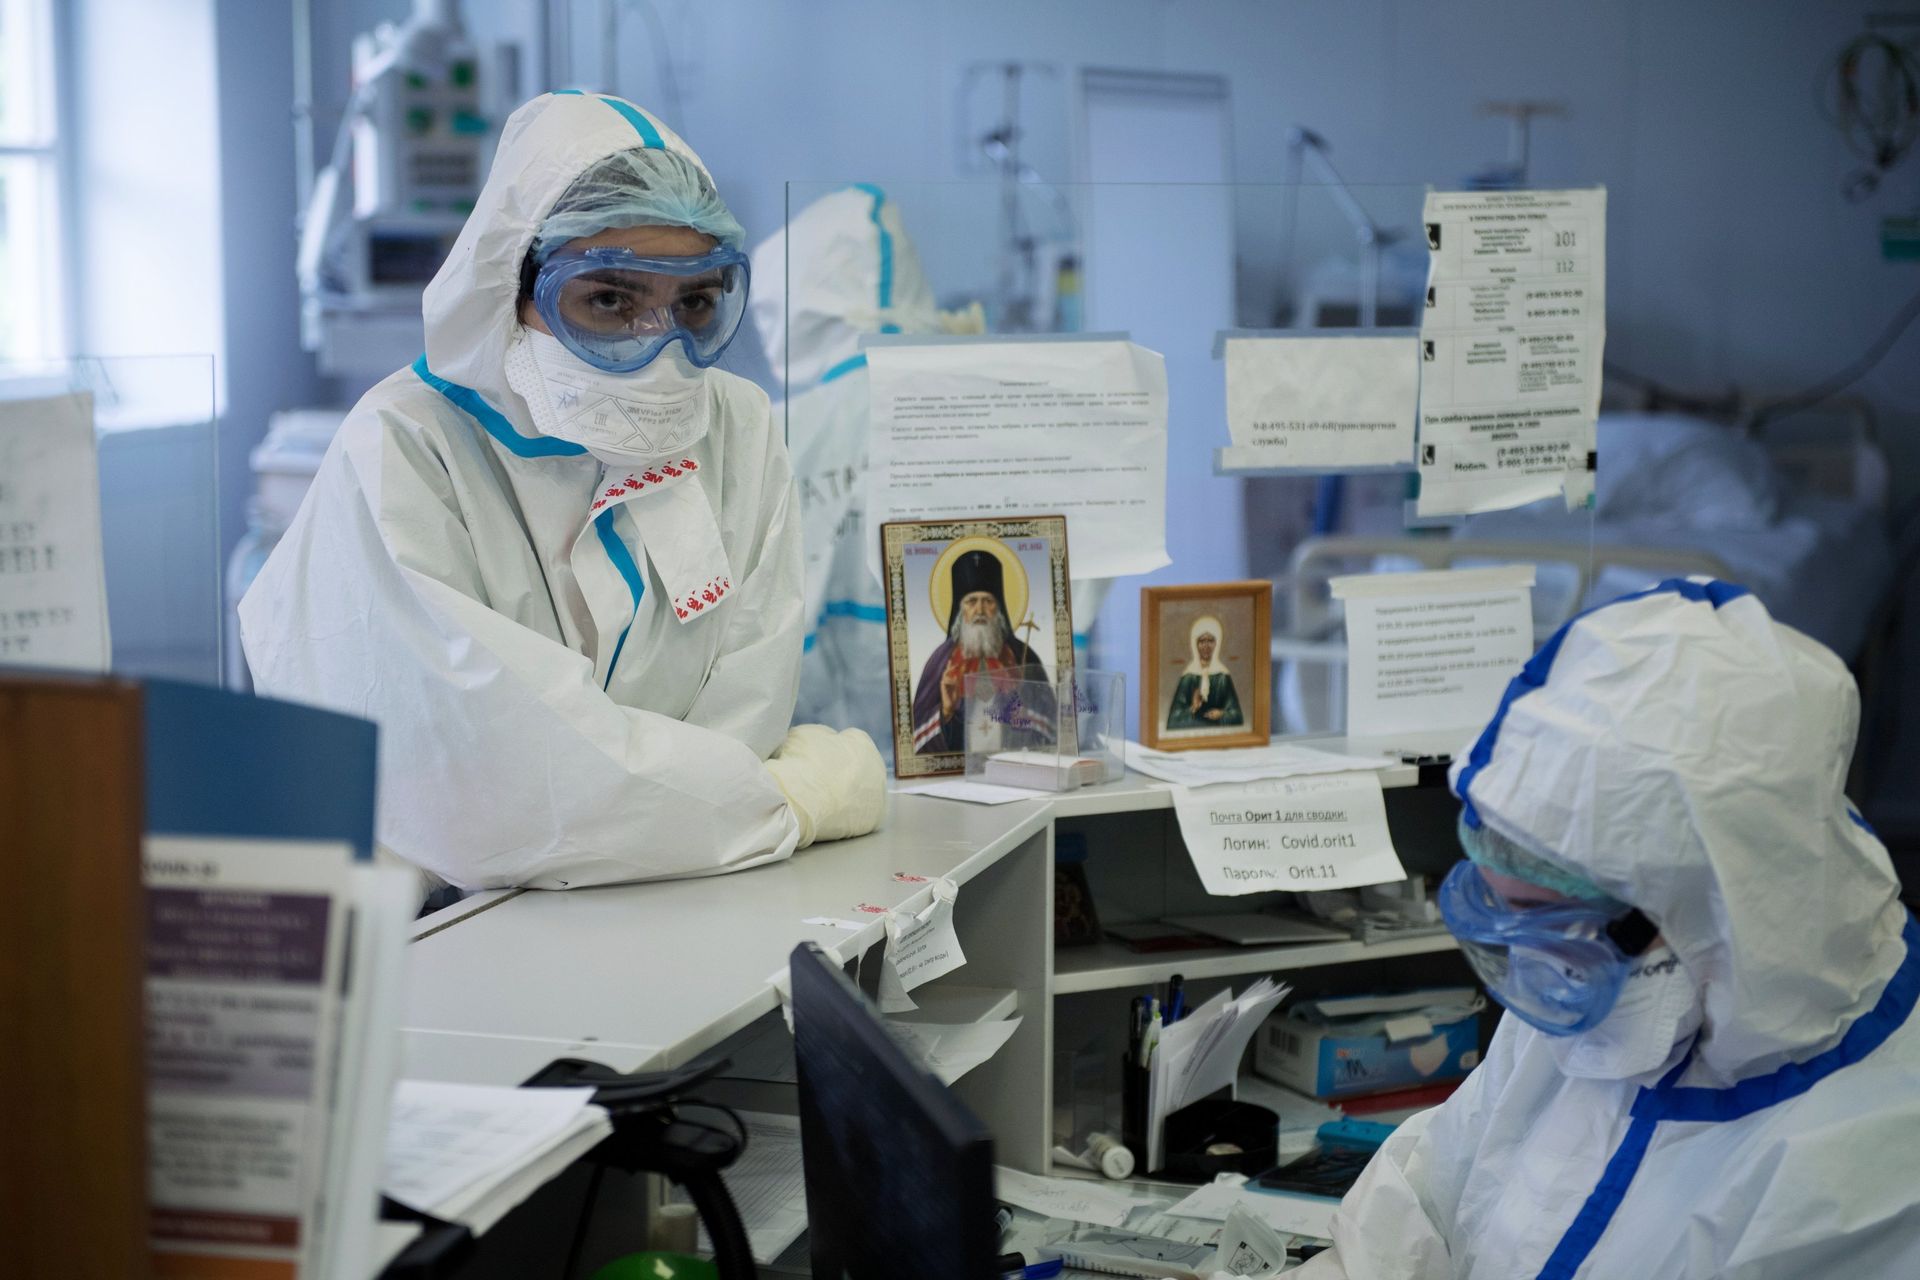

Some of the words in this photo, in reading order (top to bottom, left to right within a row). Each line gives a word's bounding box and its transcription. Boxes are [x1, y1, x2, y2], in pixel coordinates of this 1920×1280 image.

[1554, 230, 1577, 247] 101
[1556, 261, 1575, 273] 112
[605, 489, 626, 497] 3M
[623, 478, 645, 490] 3M
[642, 471, 664, 483] 3M
[661, 465, 682, 477] 3M
[687, 597, 704, 611] 3M
[702, 589, 718, 604] 3M
[1210, 810, 1242, 823] Почта
[1245, 810, 1272, 822] Орит
[1275, 810, 1281, 821] 1
[1284, 811, 1304, 822] для
[1223, 837, 1270, 851] Логин:
[1281, 833, 1356, 849] Covid.orit1
[1223, 867, 1280, 882] Пароль:
[1289, 864, 1337, 879] Orit.11
